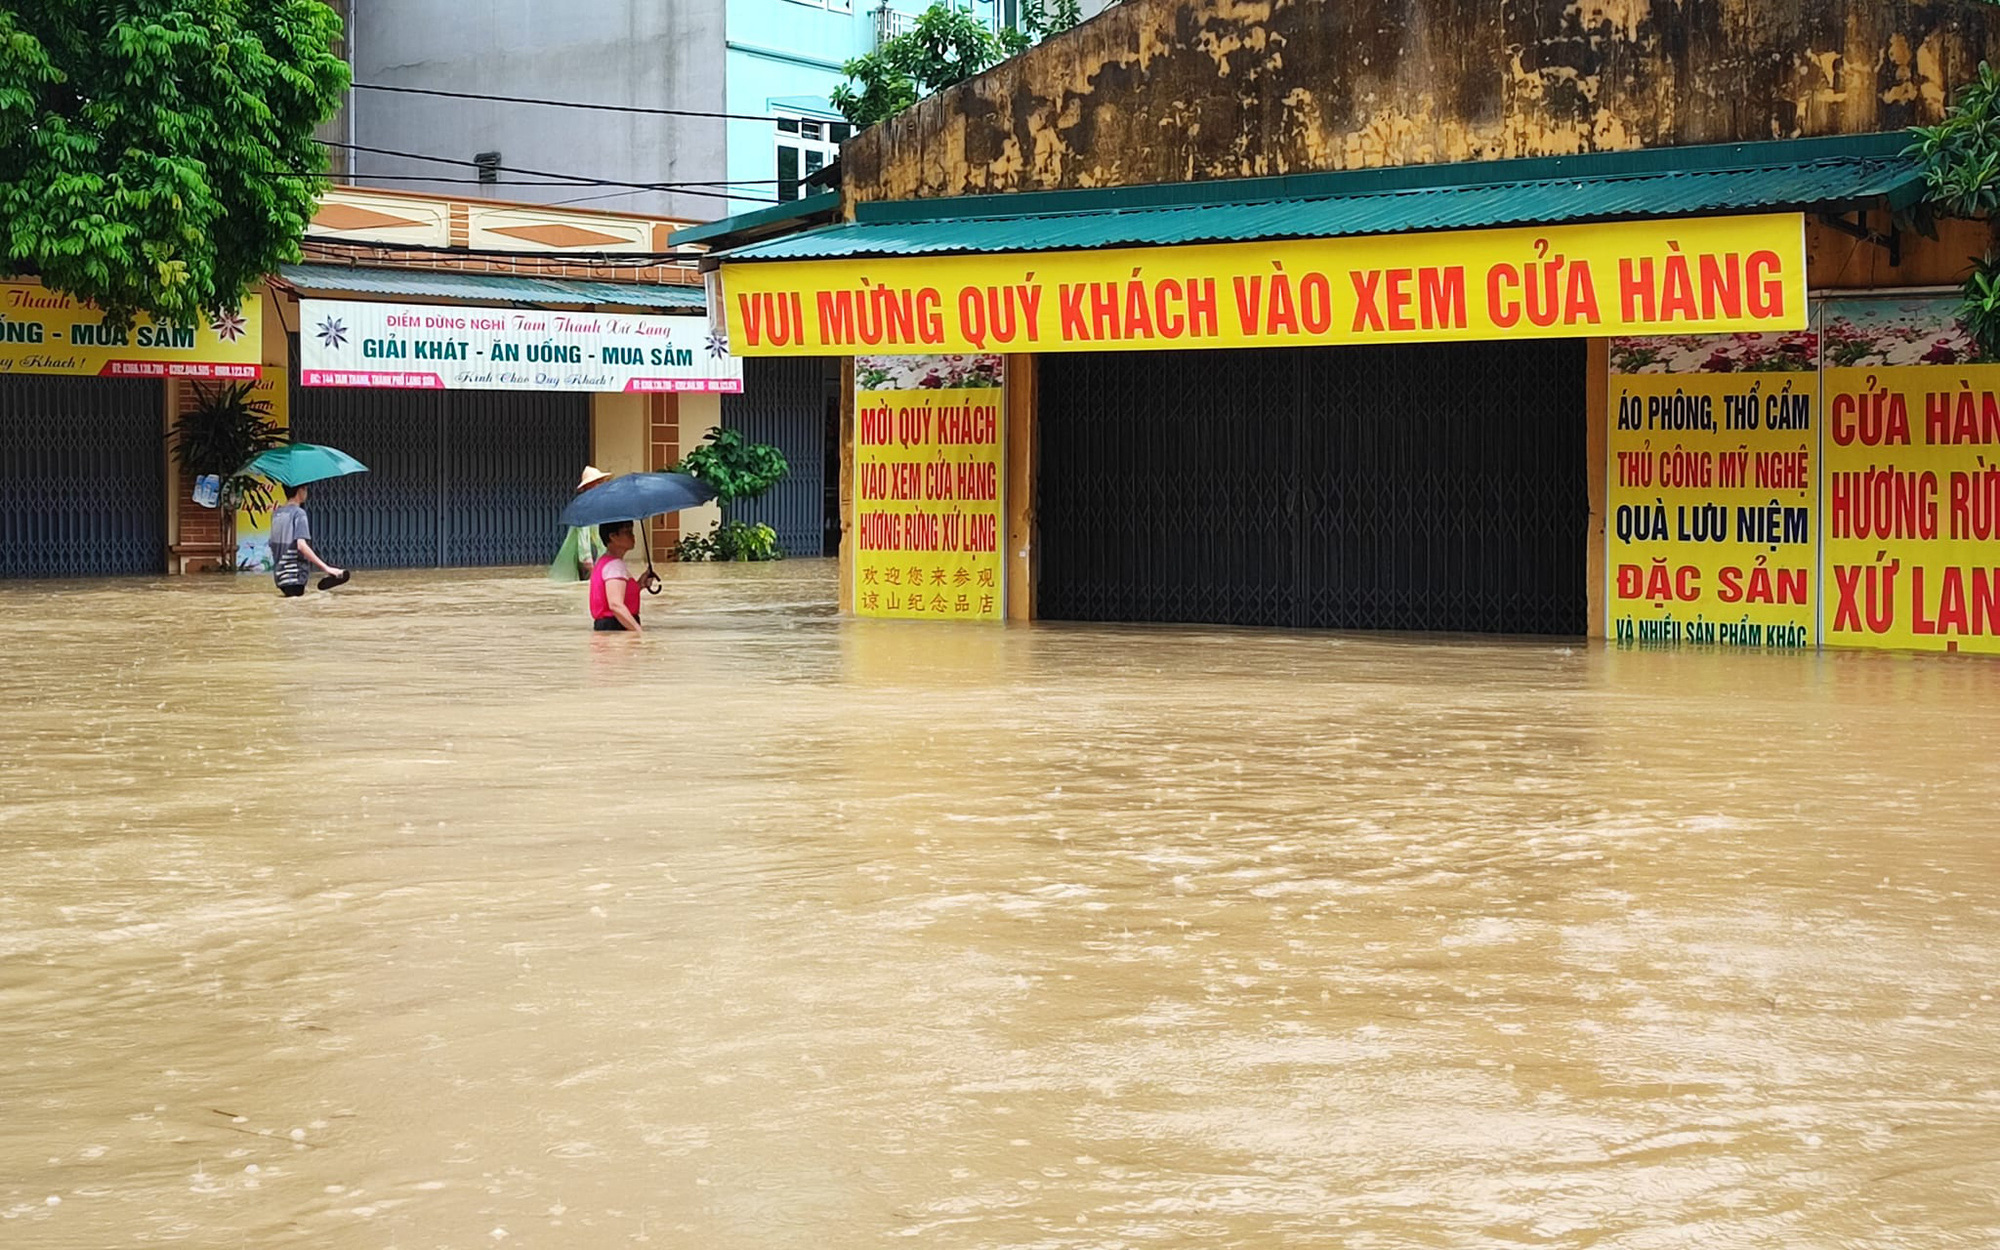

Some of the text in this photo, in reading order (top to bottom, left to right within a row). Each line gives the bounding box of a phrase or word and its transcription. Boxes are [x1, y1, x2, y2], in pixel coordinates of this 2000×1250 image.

[7, 290, 71, 309] Thanh
[738, 239, 1784, 349] VUI MỪNG QUÝ KHÁCH VÀO XEM CỬA HÀNG
[71, 324, 129, 346] MUA
[426, 314, 466, 330] DỪNG
[512, 315, 546, 331] Tam
[553, 316, 601, 333] Thanh
[363, 333, 407, 359] GIẢI
[415, 338, 469, 360] KHÁT
[491, 340, 519, 362] ĂN
[527, 339, 581, 363] UỐNG
[602, 346, 645, 365] MUA
[651, 341, 692, 367] SẮM
[860, 397, 996, 449] MỜI QUÝ KHÁCH
[1617, 380, 1809, 434] ÁO PHÔNG, THỔ CẨM
[1832, 375, 1911, 446] CỬA
[860, 449, 996, 501] VÀO XEM CỬA HÀNG
[1617, 439, 1808, 497] THỦ CÔNG MỸ NGHỆ
[1832, 455, 2000, 541] HƯƠNG RỪ
[860, 505, 996, 561] HƯƠNG RỪNG XỨ LẠNG
[1616, 498, 1808, 551] QUÀ LƯU NIỆM
[861, 590, 994, 614] 谅山纪念品店
[862, 565, 995, 588] 欢迎您来参观
[1616, 554, 1808, 608] ĐẶC SẢN
[1833, 550, 1900, 634] XỨ
[1616, 614, 1634, 640] VÀ
[1686, 614, 1715, 643] SẢN
[1720, 614, 1761, 645] PHẨM
[1766, 620, 1806, 647] KHÁC
